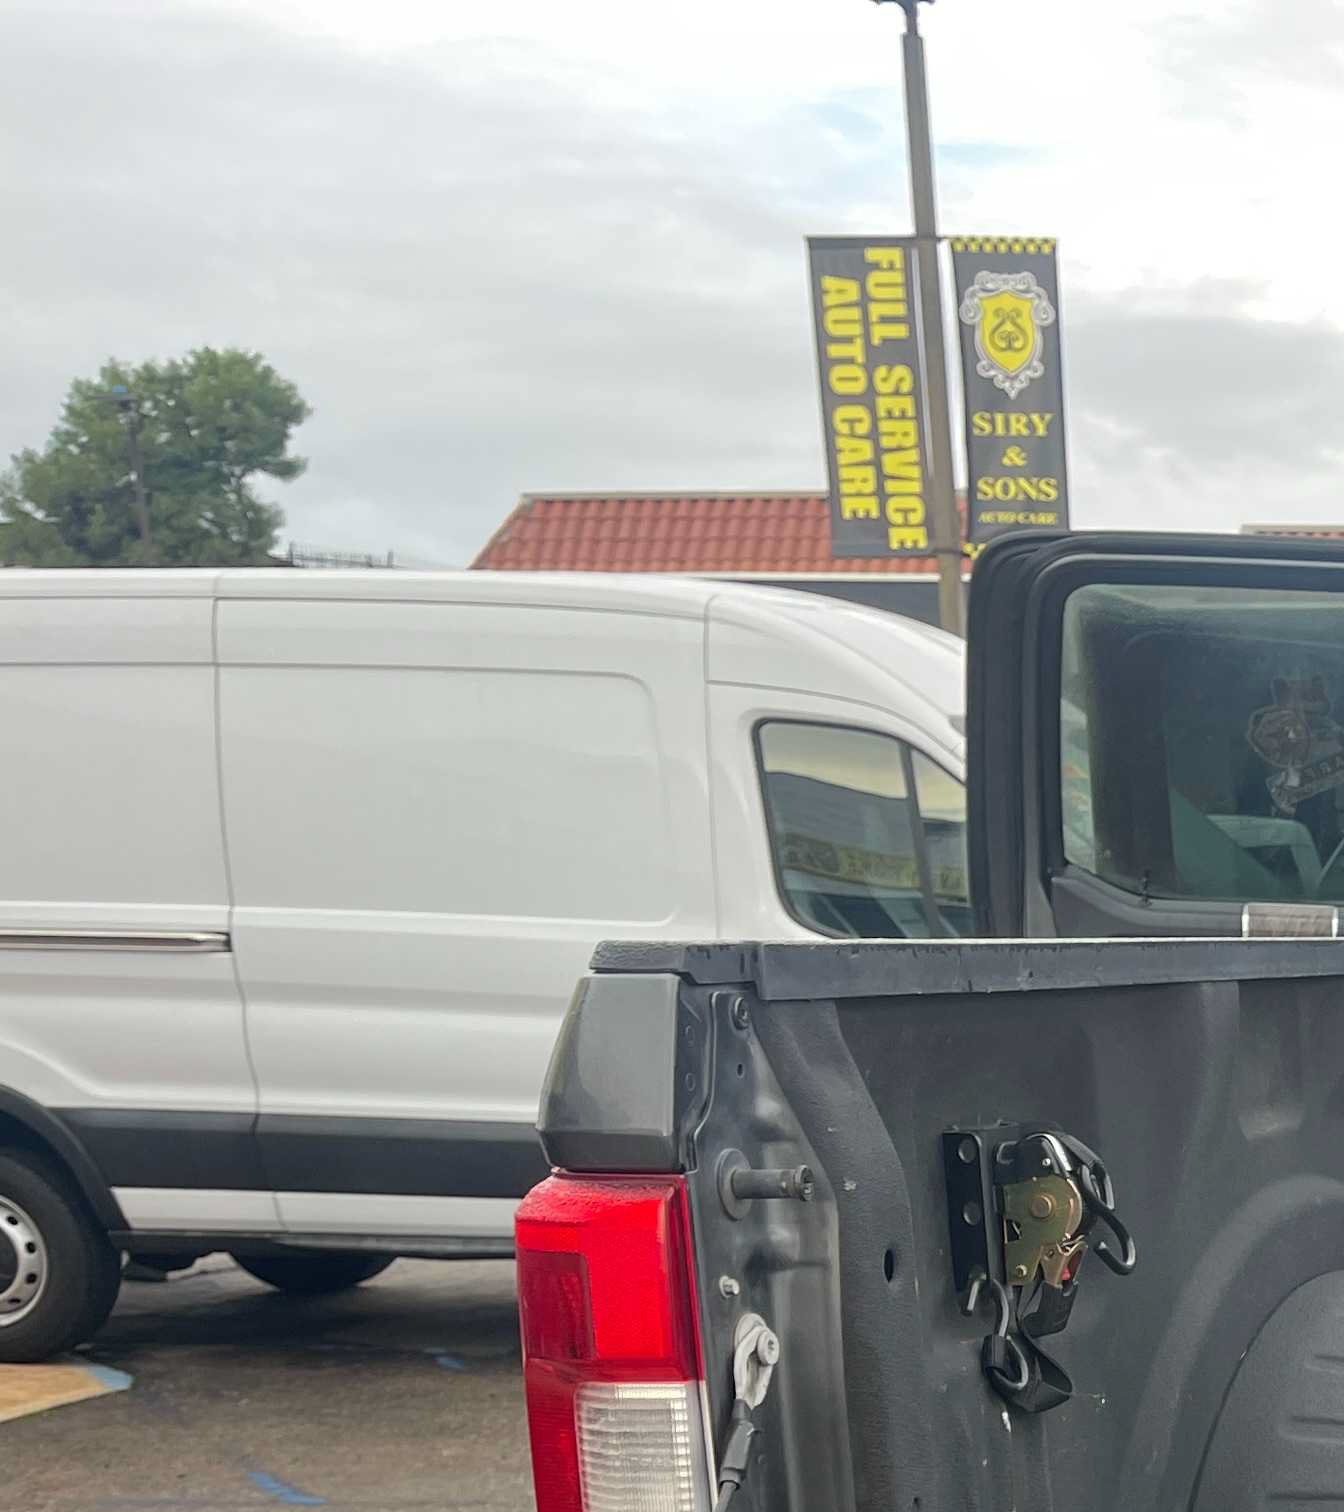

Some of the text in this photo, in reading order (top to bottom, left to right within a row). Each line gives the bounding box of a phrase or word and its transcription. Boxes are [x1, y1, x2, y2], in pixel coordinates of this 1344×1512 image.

[820, 275, 880, 521] AUTO CARE
[864, 246, 929, 550] FULL SERVICE
[972, 411, 1055, 437] SIRY
[1002, 446, 1028, 467] &
[976, 477, 1058, 502] SONS
